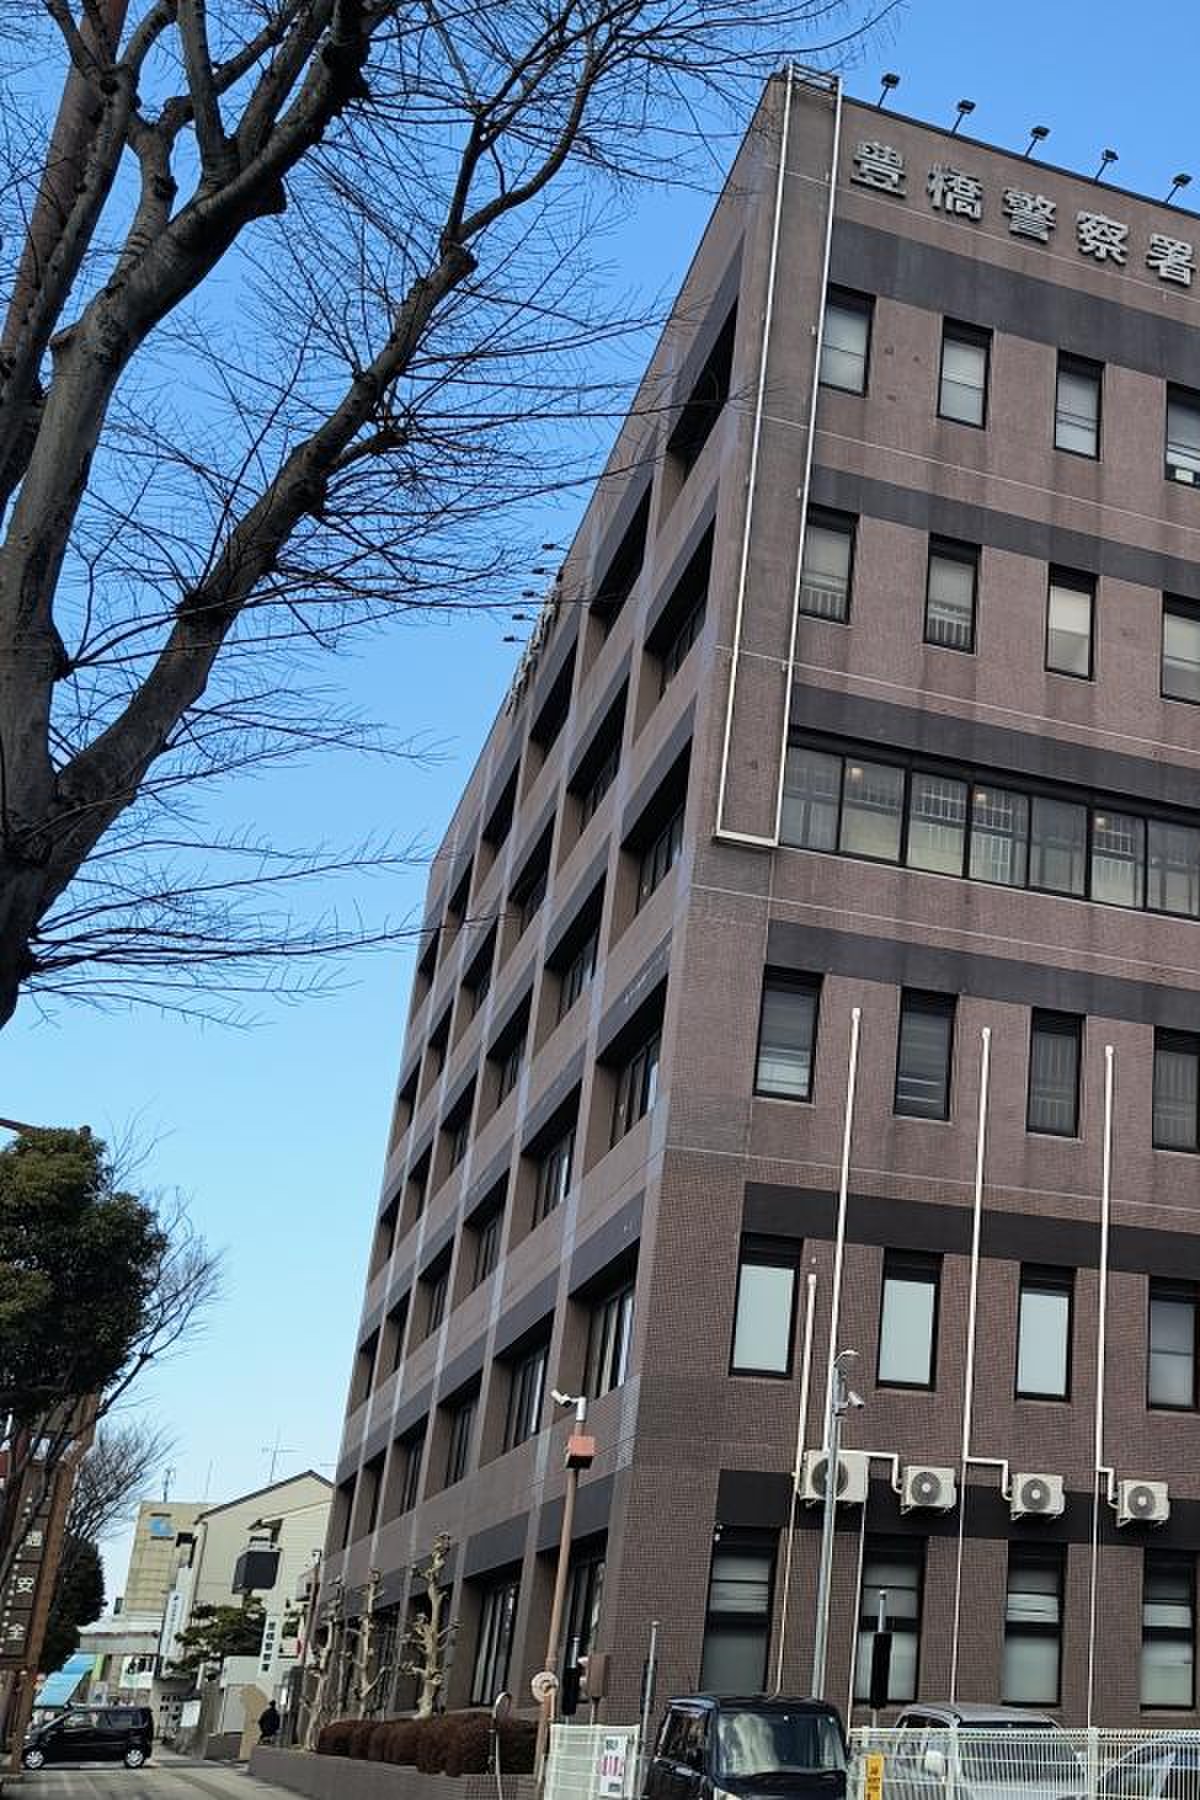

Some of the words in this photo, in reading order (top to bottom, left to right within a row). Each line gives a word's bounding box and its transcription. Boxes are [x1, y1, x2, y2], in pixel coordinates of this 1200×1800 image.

[850, 140, 1197, 286] 豊橋警察署
